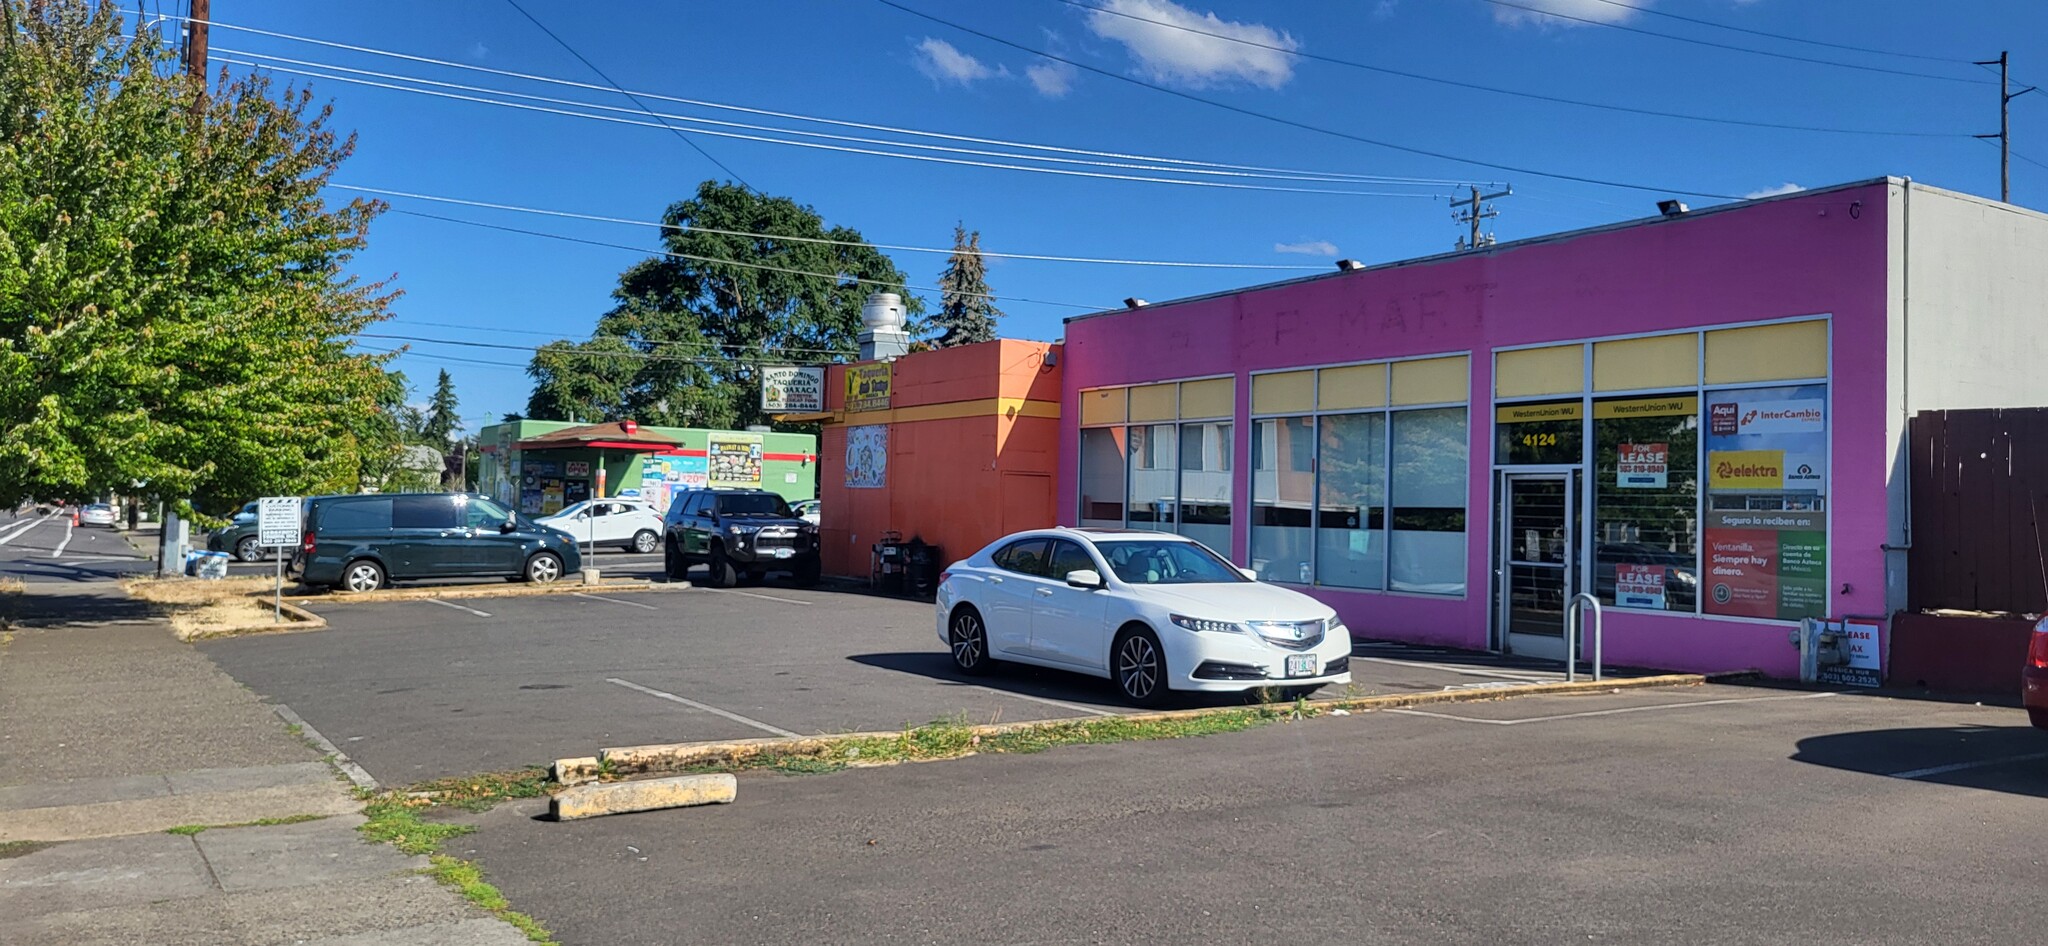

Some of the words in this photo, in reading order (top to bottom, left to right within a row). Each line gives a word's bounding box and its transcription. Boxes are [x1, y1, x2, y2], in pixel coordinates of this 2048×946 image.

[766, 371, 787, 382] SANTO
[788, 372, 819, 384] DOMINGO
[1760, 408, 1821, 420] InterCambio
[1522, 434, 1556, 446] 4124
[1632, 444, 1650, 452] FOR
[1620, 452, 1664, 463] LEASE
[1734, 464, 1778, 478] elektra
[1722, 516, 1751, 526] Seguro
[1753, 516, 1761, 525] lo
[1762, 516, 1795, 526] reciben
[1797, 518, 1811, 526] en:
[1712, 542, 1754, 552] Ventanilla.
[1712, 554, 1748, 566] Siempre
[1751, 555, 1768, 567] hay
[1631, 565, 1649, 573] FOR
[1712, 566, 1744, 576] dinero.
[1618, 573, 1662, 584] LEASE
[1848, 631, 1870, 640] EASE
